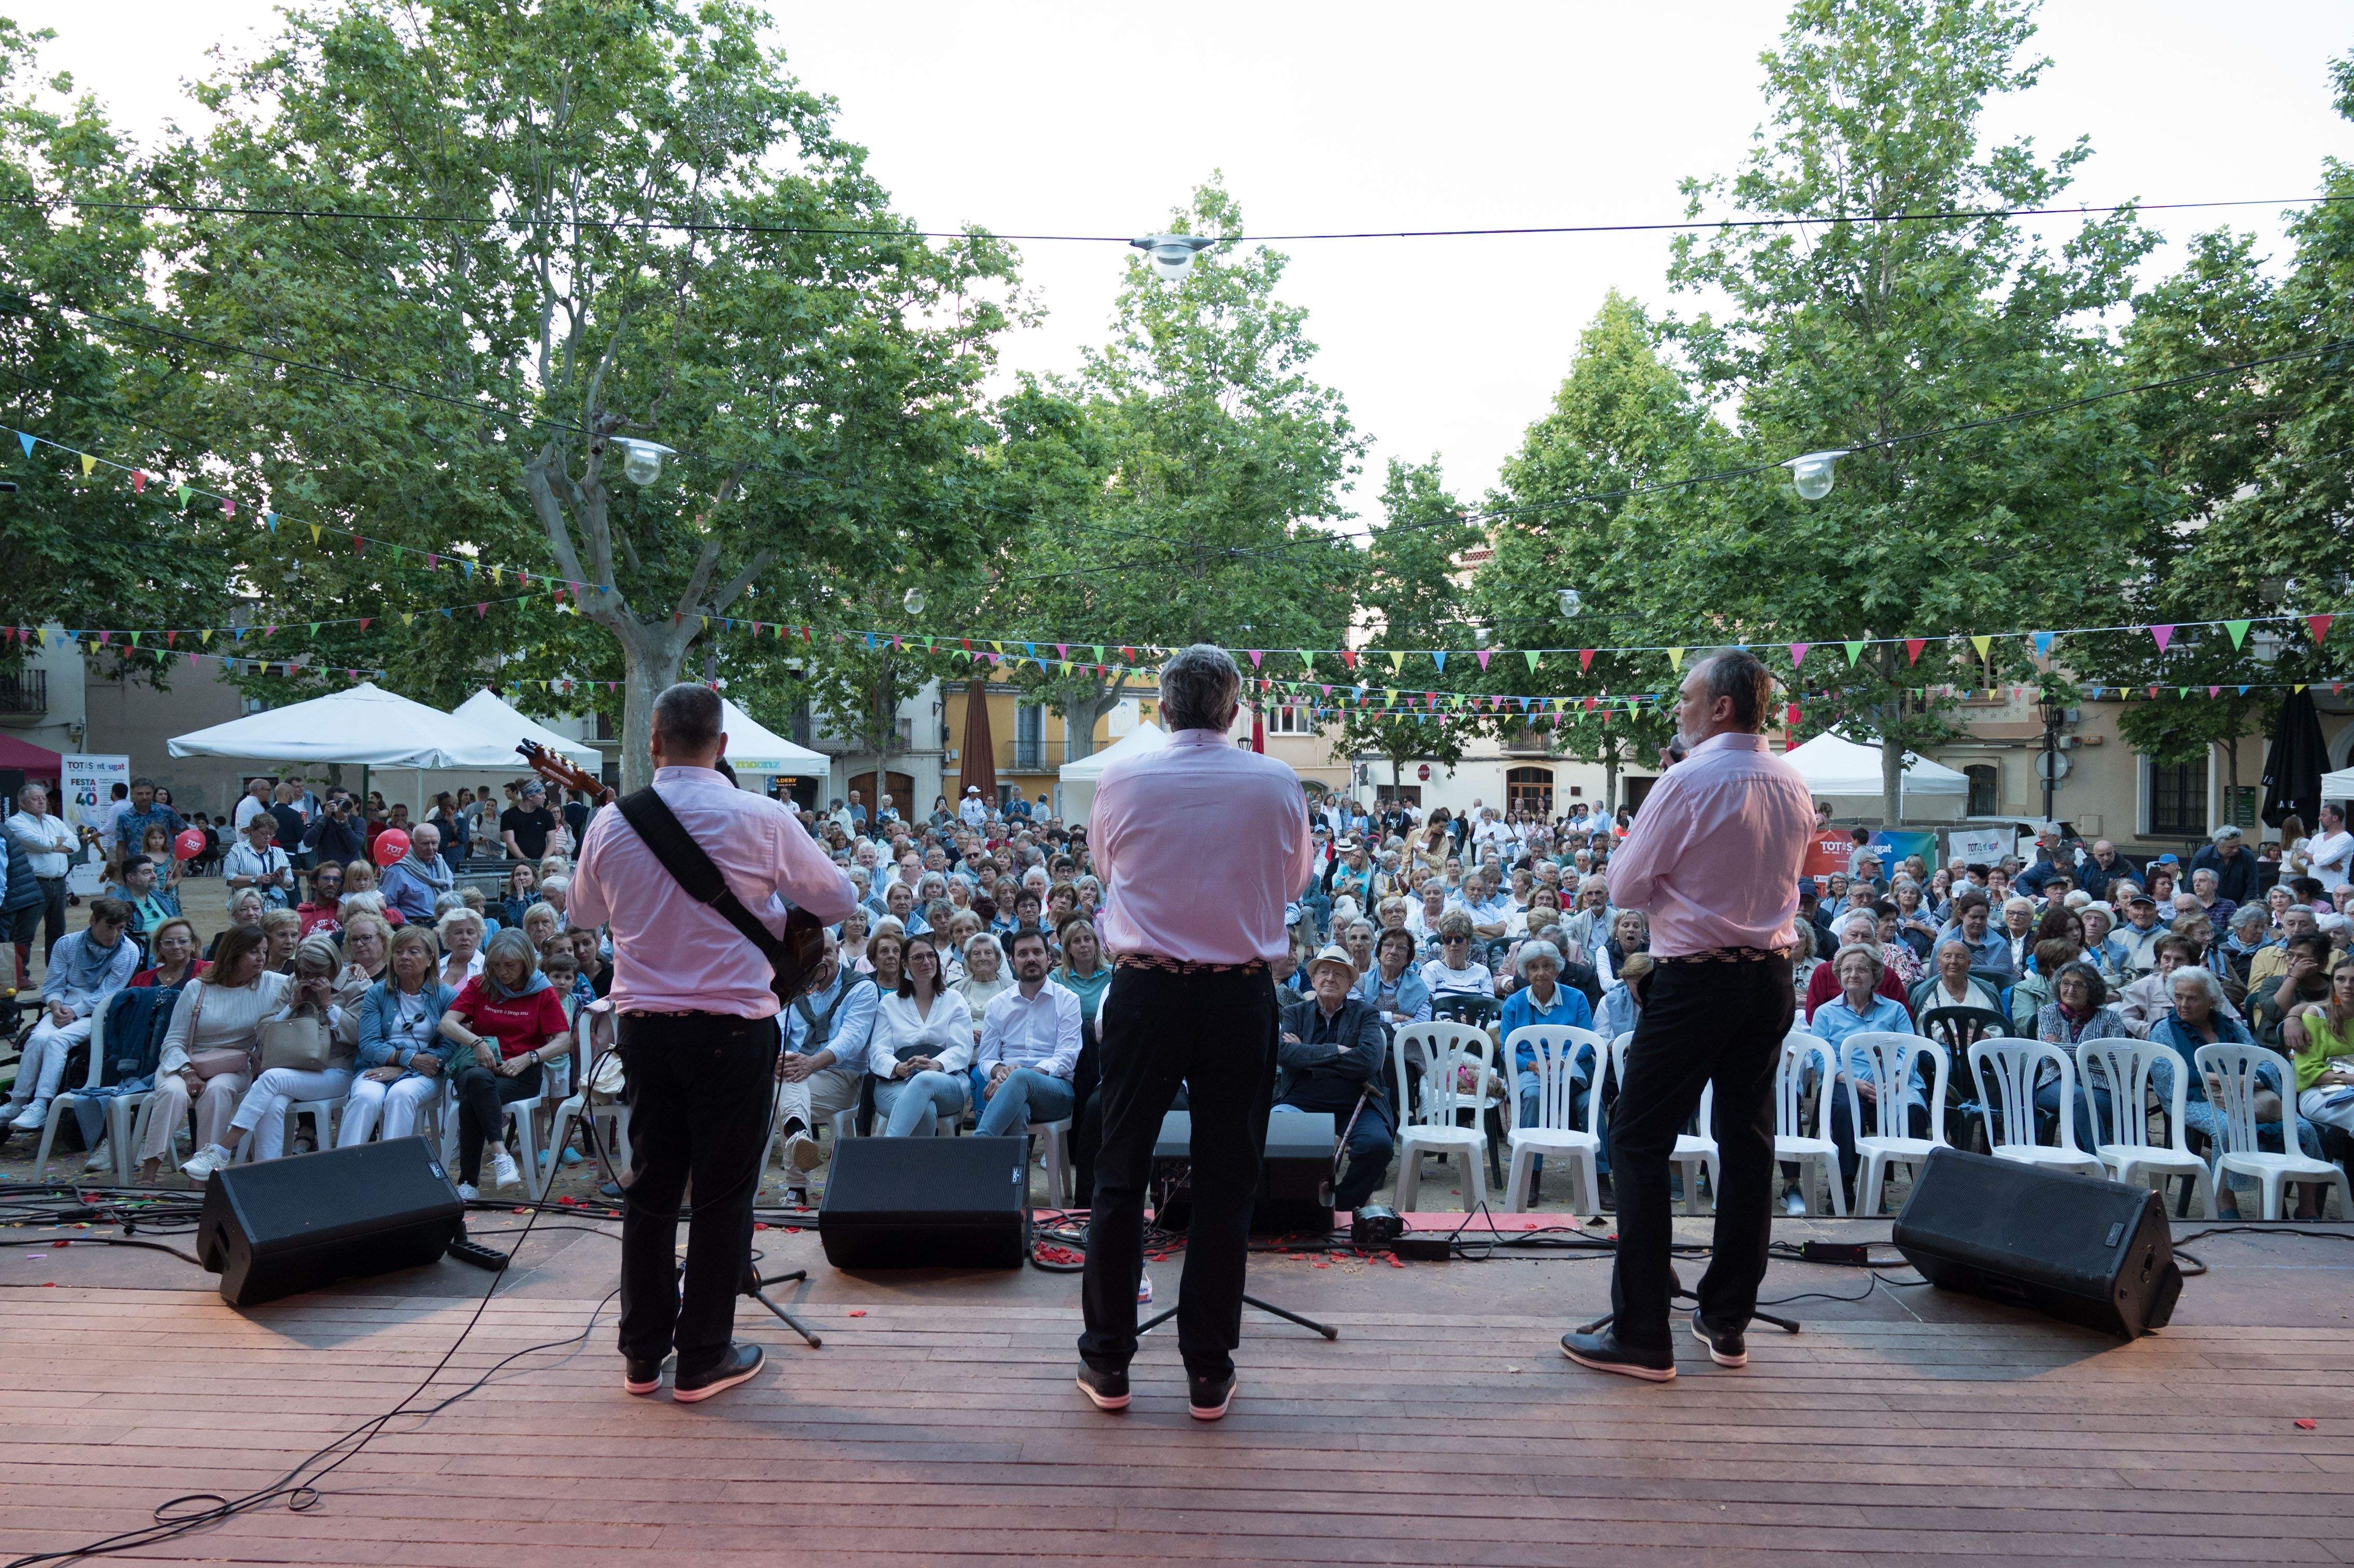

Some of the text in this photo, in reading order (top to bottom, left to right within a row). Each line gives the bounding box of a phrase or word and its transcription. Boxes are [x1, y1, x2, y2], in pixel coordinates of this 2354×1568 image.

[75, 792, 97, 806] 40
[188, 839, 201, 848] TOT
[387, 843, 403, 854] TOT
[1820, 841, 1841, 851] TOT
[1870, 843, 1892, 854] ugat
[484, 1005, 503, 1013] Sempre
